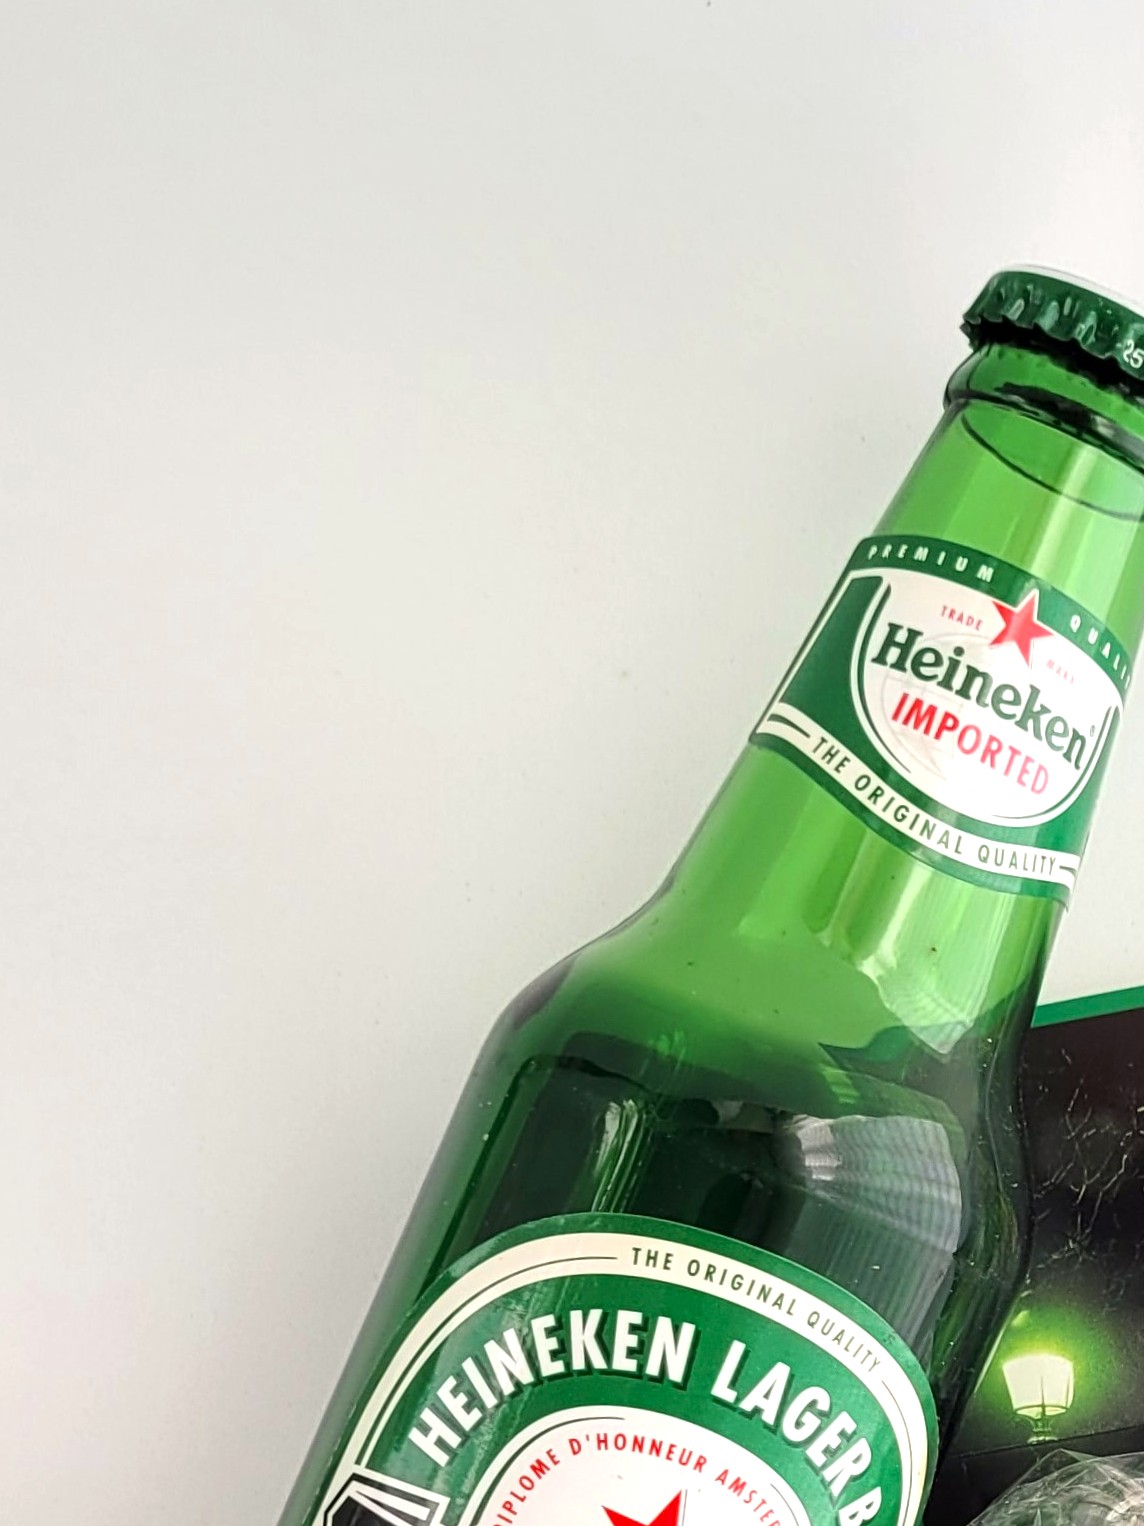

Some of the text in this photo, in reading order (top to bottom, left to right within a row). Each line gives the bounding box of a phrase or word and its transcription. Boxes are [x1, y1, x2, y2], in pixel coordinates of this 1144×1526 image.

[868, 544, 995, 583] PREMIUM
[940, 605, 984, 631] TRADE
[871, 622, 1086, 771] Heineken
[891, 692, 1050, 796] IMPORTED
[811, 736, 1057, 876] THE ORIGINAL QUALITY
[631, 1246, 883, 1374] THE ORIGINAL QUALITY
[407, 1308, 697, 1468] HEINEKEN
[710, 1339, 873, 1495] LAGER
[568, 1432, 708, 1474] D'HONNEUR
